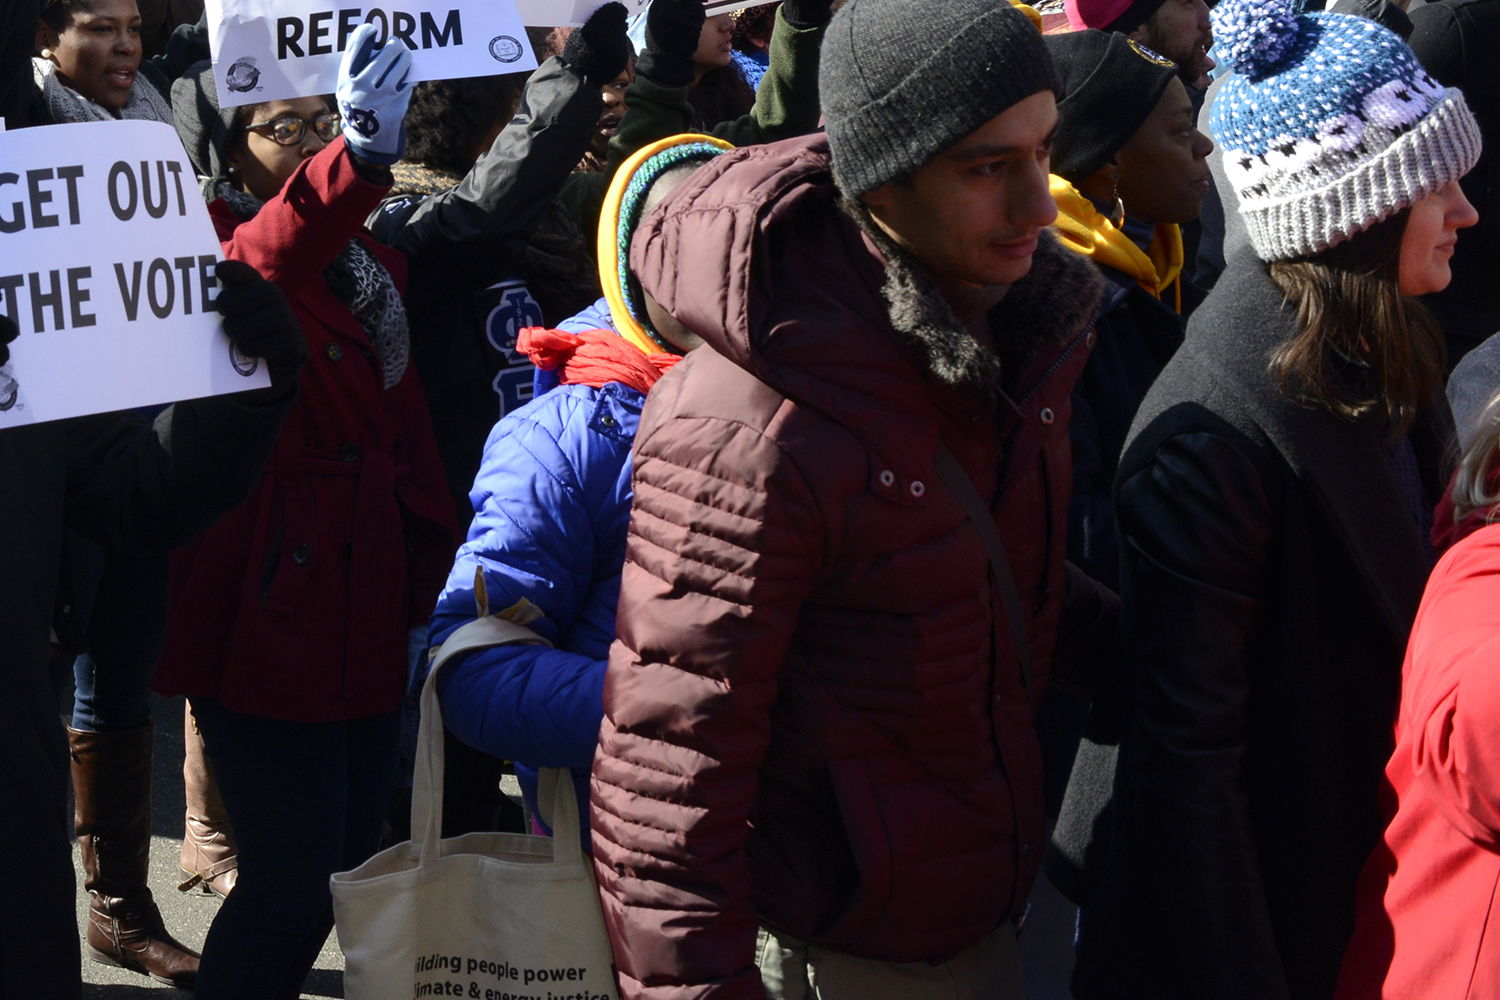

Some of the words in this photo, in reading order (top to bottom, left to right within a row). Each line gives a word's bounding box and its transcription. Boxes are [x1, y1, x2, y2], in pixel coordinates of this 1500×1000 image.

[277, 7, 463, 61] REFORM
[107, 160, 187, 221] OUT
[0, 265, 97, 337] THE
[114, 253, 219, 322] VOTE
[467, 957, 519, 981] people
[523, 966, 587, 986] power
[468, 981, 481, 999] &
